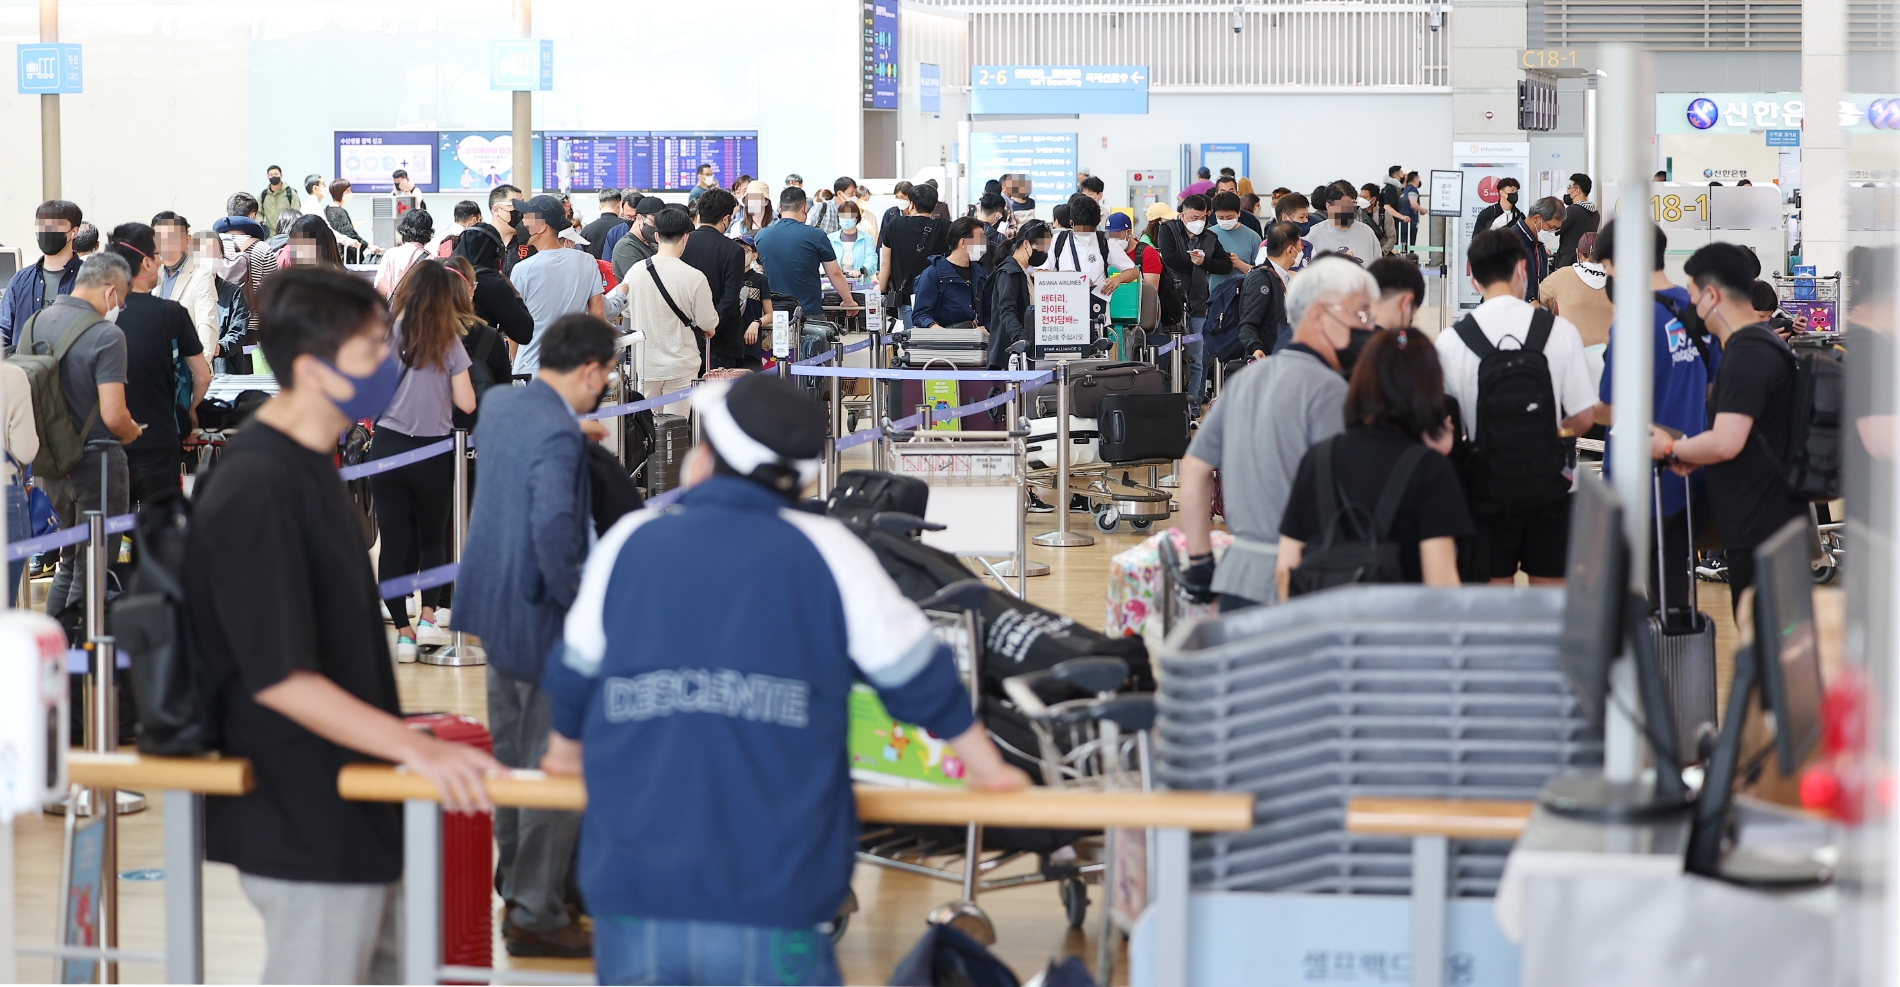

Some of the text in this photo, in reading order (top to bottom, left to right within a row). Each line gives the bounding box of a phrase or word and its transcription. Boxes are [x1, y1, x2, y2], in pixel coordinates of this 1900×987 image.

[67, 54, 80, 70] 카트
[1522, 50, 1577, 67] C18-1
[979, 69, 1007, 85] 2-6
[1714, 169, 1747, 178] 신한은행
[1483, 188, 1489, 197] 5
[1615, 194, 1708, 222] 18-1
[1041, 294, 1068, 303] 배터리,
[1041, 305, 1068, 314] 라이터,
[1041, 316, 1079, 325] 전자담배는
[1060, 333, 1083, 341] 주십시오
[603, 667, 810, 729] DESCENTE
[1302, 950, 1475, 985] 셀프백드용
